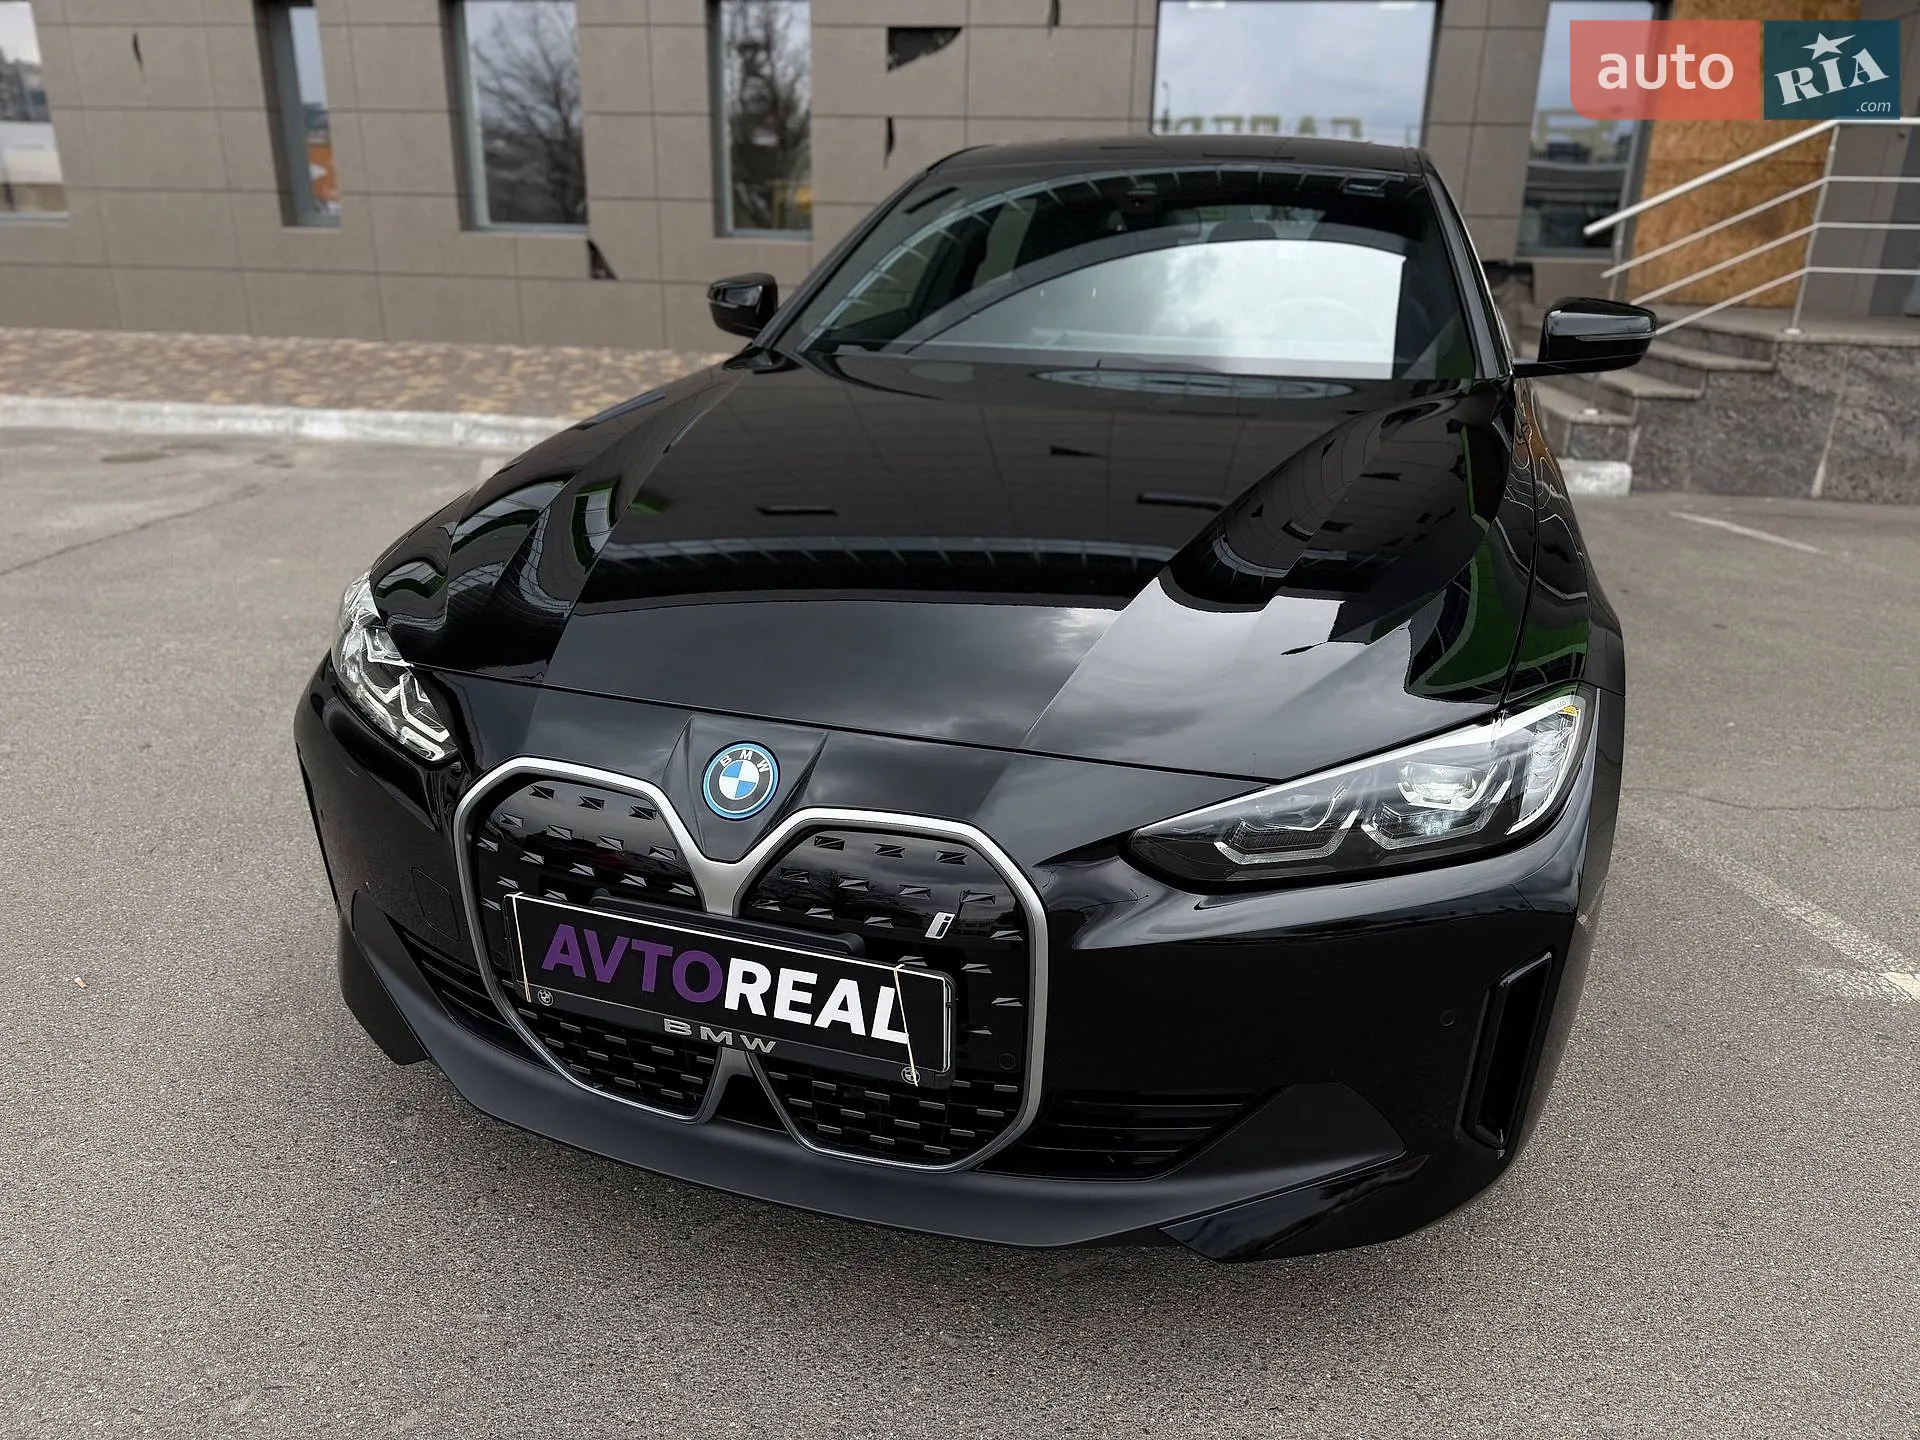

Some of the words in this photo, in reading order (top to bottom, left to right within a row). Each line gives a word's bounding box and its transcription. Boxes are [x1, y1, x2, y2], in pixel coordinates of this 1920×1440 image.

[720, 749, 770, 773] BMW
[541, 923, 909, 1045] AVTOREAL
[664, 1018, 776, 1053] BMW
